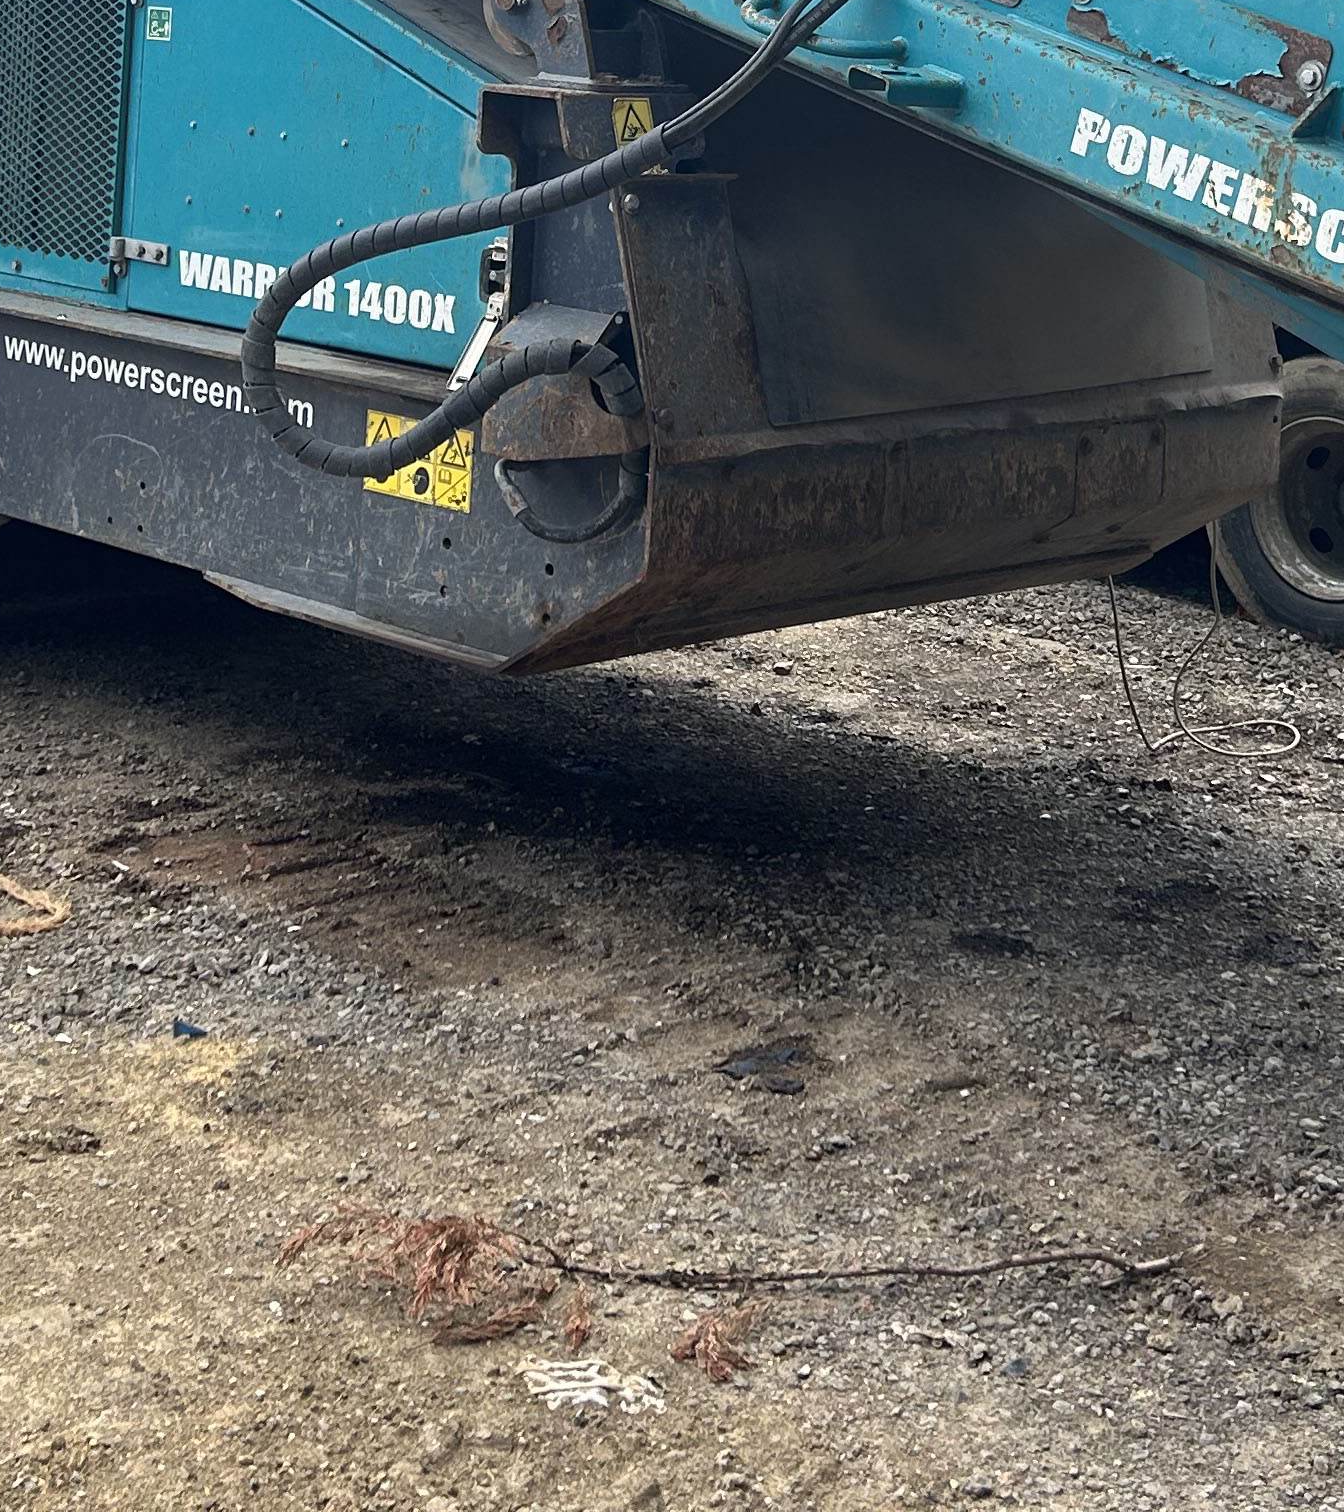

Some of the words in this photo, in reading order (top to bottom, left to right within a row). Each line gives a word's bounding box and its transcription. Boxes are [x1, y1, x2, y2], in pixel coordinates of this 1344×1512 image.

[179, 249, 336, 313] WARRR
[343, 279, 456, 334] 1400X
[4, 335, 314, 428] www.powerscreen.m
